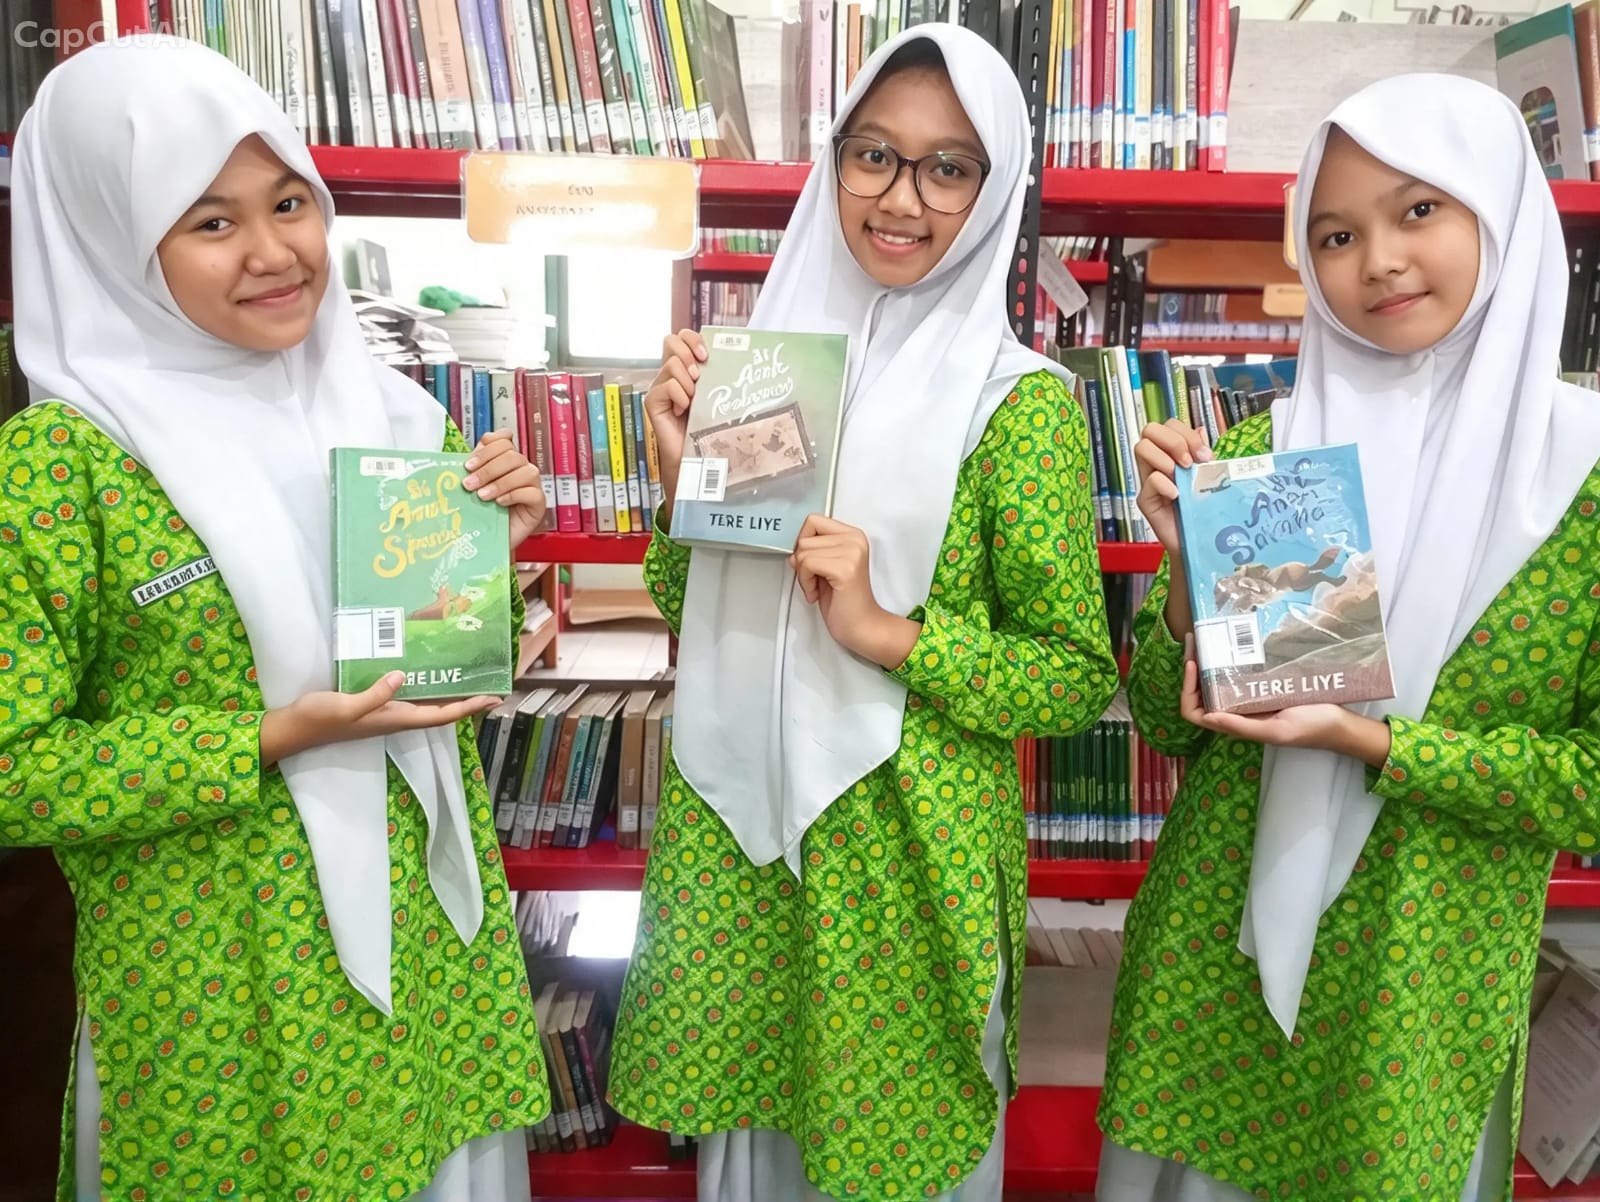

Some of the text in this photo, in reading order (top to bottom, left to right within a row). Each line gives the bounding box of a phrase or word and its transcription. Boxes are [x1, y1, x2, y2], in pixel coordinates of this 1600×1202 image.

[709, 513, 782, 531] TERE LIYE
[1246, 672, 1345, 698] TERE LIYE
